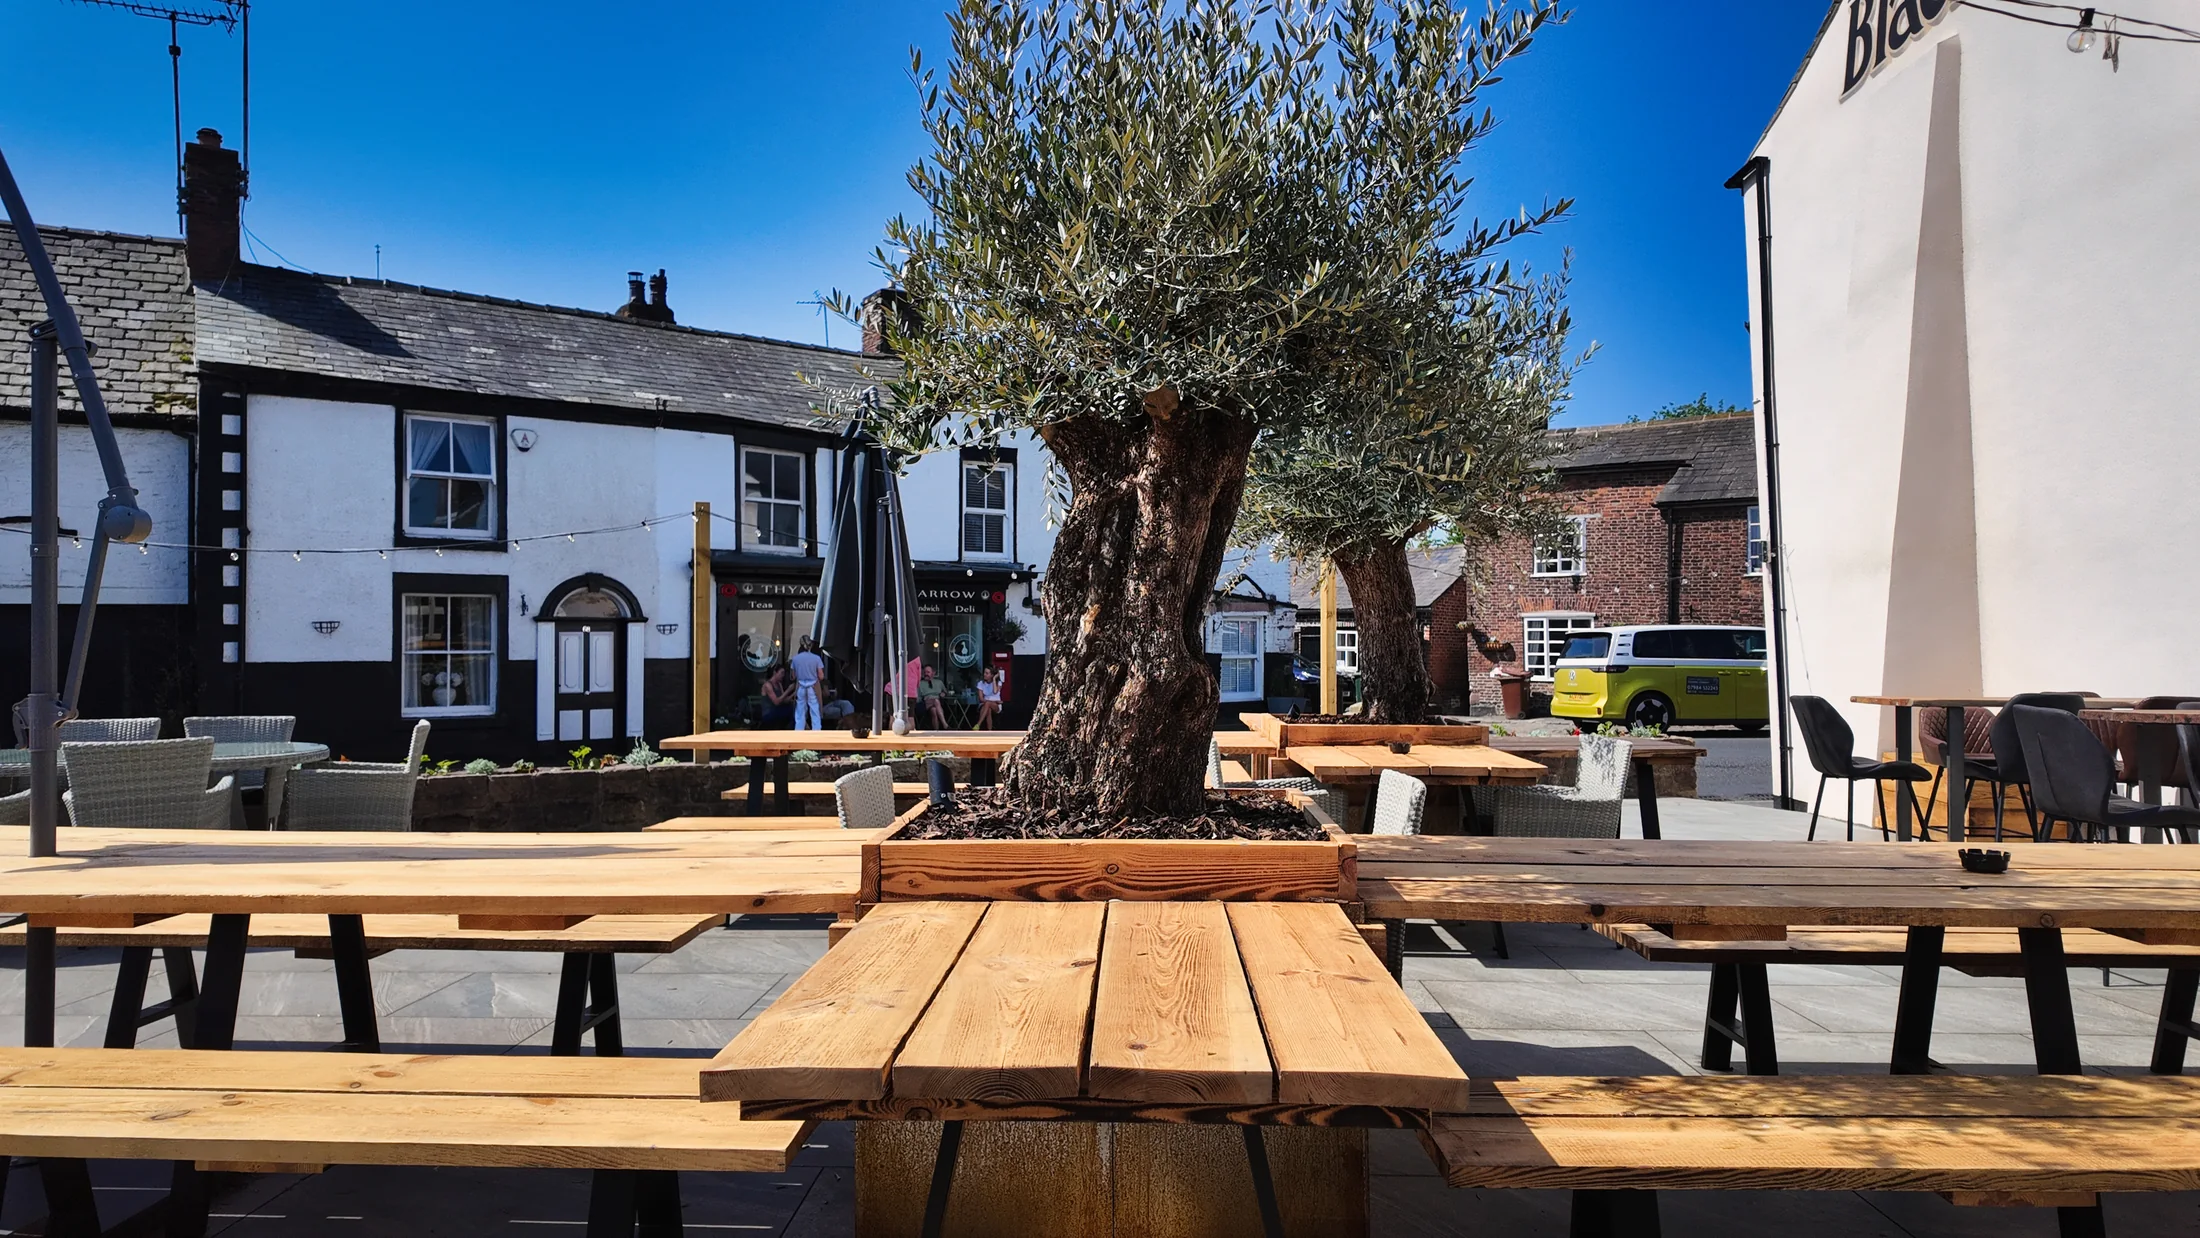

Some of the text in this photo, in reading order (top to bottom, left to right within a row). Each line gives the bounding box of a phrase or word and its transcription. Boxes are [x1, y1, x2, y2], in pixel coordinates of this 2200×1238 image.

[918, 590, 975, 598] ARROW
[748, 601, 773, 609] Teas
[918, 604, 940, 612] ndwich
[955, 605, 975, 613] Deli
